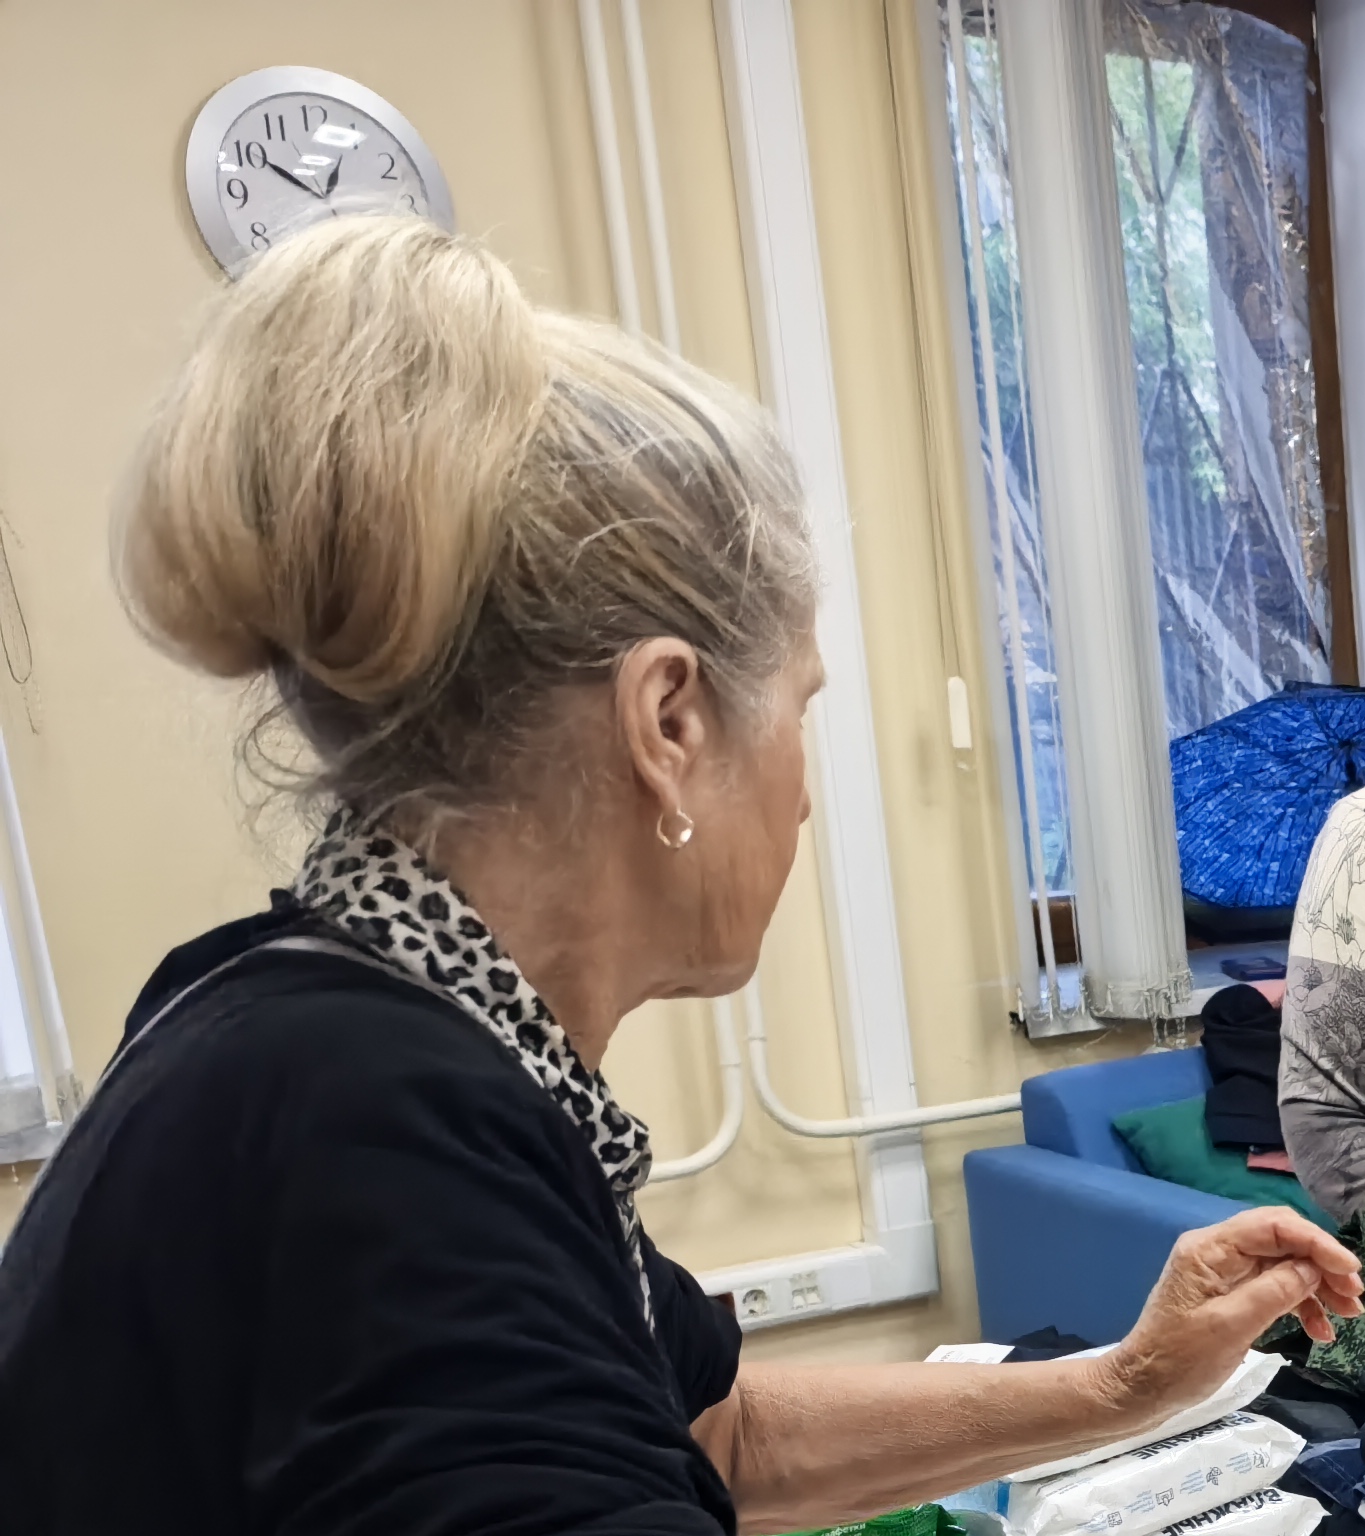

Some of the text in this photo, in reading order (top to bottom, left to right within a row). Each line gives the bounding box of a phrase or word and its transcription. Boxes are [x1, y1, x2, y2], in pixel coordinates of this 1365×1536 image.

[264, 112, 286, 142] 11
[234, 139, 268, 170] 10
[378, 152, 398, 181] 2
[227, 178, 249, 210] 9
[250, 221, 271, 250] 8
